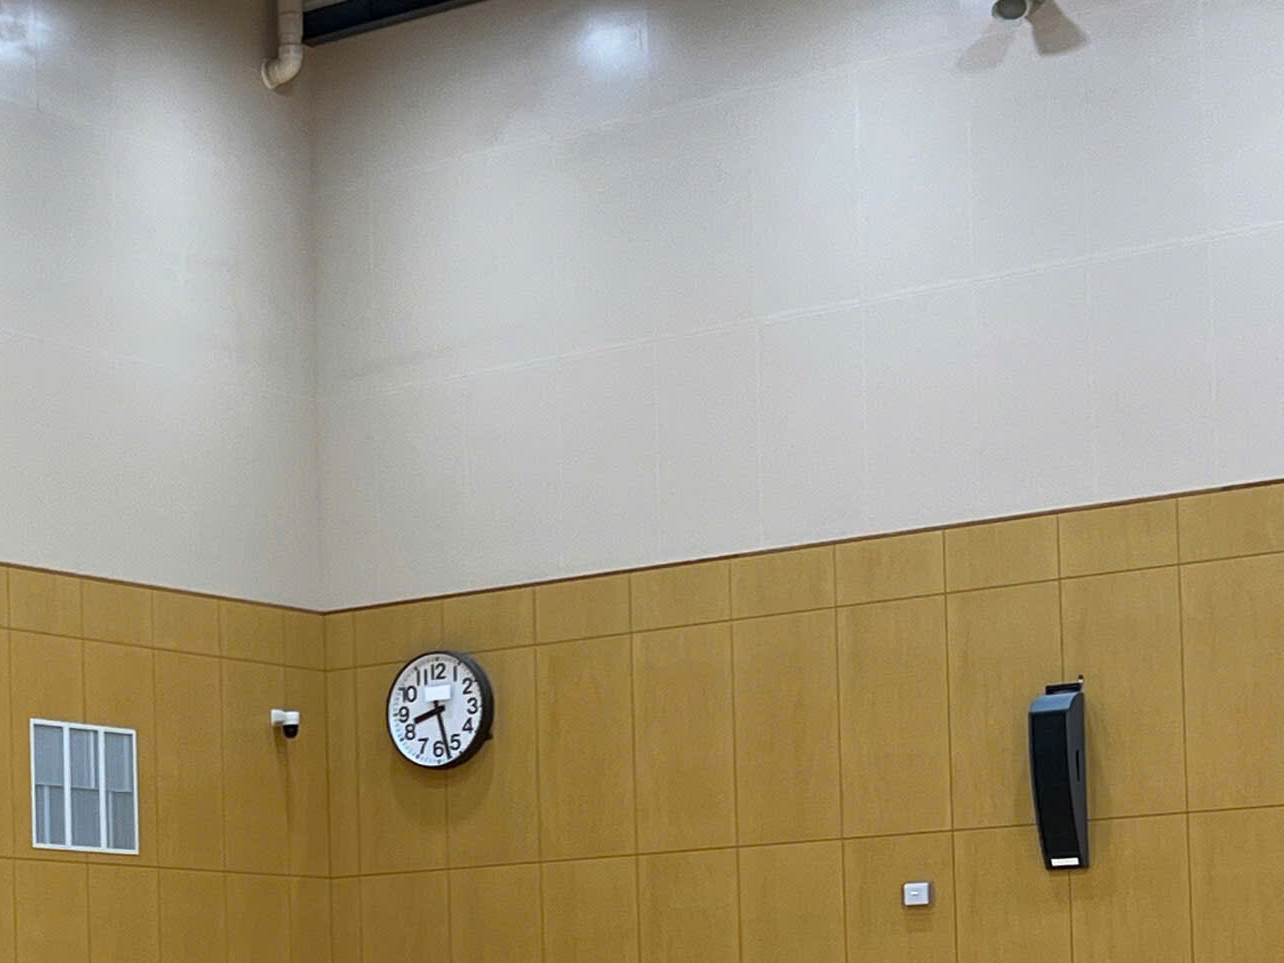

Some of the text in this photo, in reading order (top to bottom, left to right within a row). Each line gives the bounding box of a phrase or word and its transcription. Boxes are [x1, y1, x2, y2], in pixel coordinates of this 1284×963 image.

[416, 668, 428, 686] 11
[431, 663, 446, 680] 12
[398, 686, 417, 703] 10
[462, 678, 473, 695] 2
[467, 697, 478, 714] 3
[399, 706, 410, 723] 9
[405, 723, 416, 740] 8
[462, 717, 474, 734] 4
[418, 738, 429, 754] 7
[433, 741, 444, 758] 6
[450, 734, 461, 751] 5
